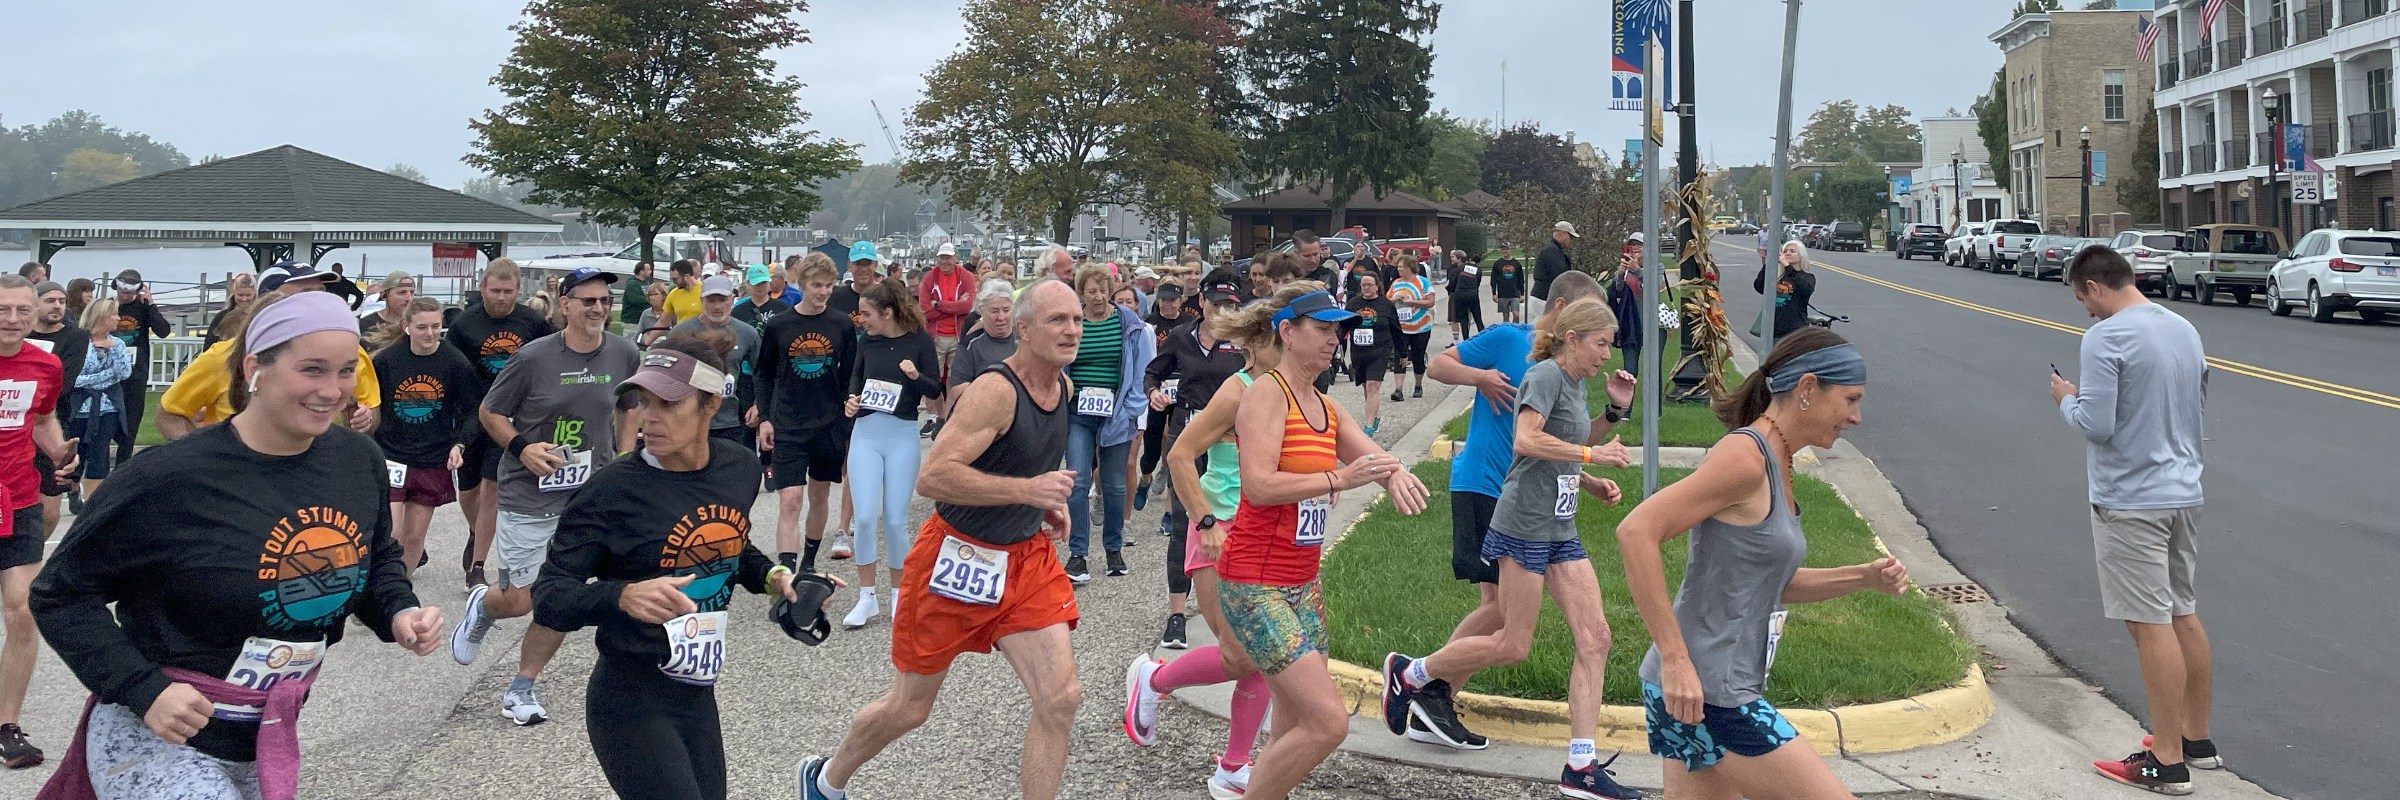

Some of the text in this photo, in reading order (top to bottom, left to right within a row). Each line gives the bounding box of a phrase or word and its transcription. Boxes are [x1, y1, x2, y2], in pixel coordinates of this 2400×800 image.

[2294, 188, 2317, 200] 25
[1354, 334, 1373, 344] 2912
[861, 390, 897, 409] 2934
[1079, 397, 1112, 413] 2892
[541, 464, 589, 486] 2937
[257, 506, 369, 580] STOUT STUMBLE
[660, 514, 694, 568] STOUT
[933, 557, 1000, 600] 2951
[662, 639, 723, 677] 2548
